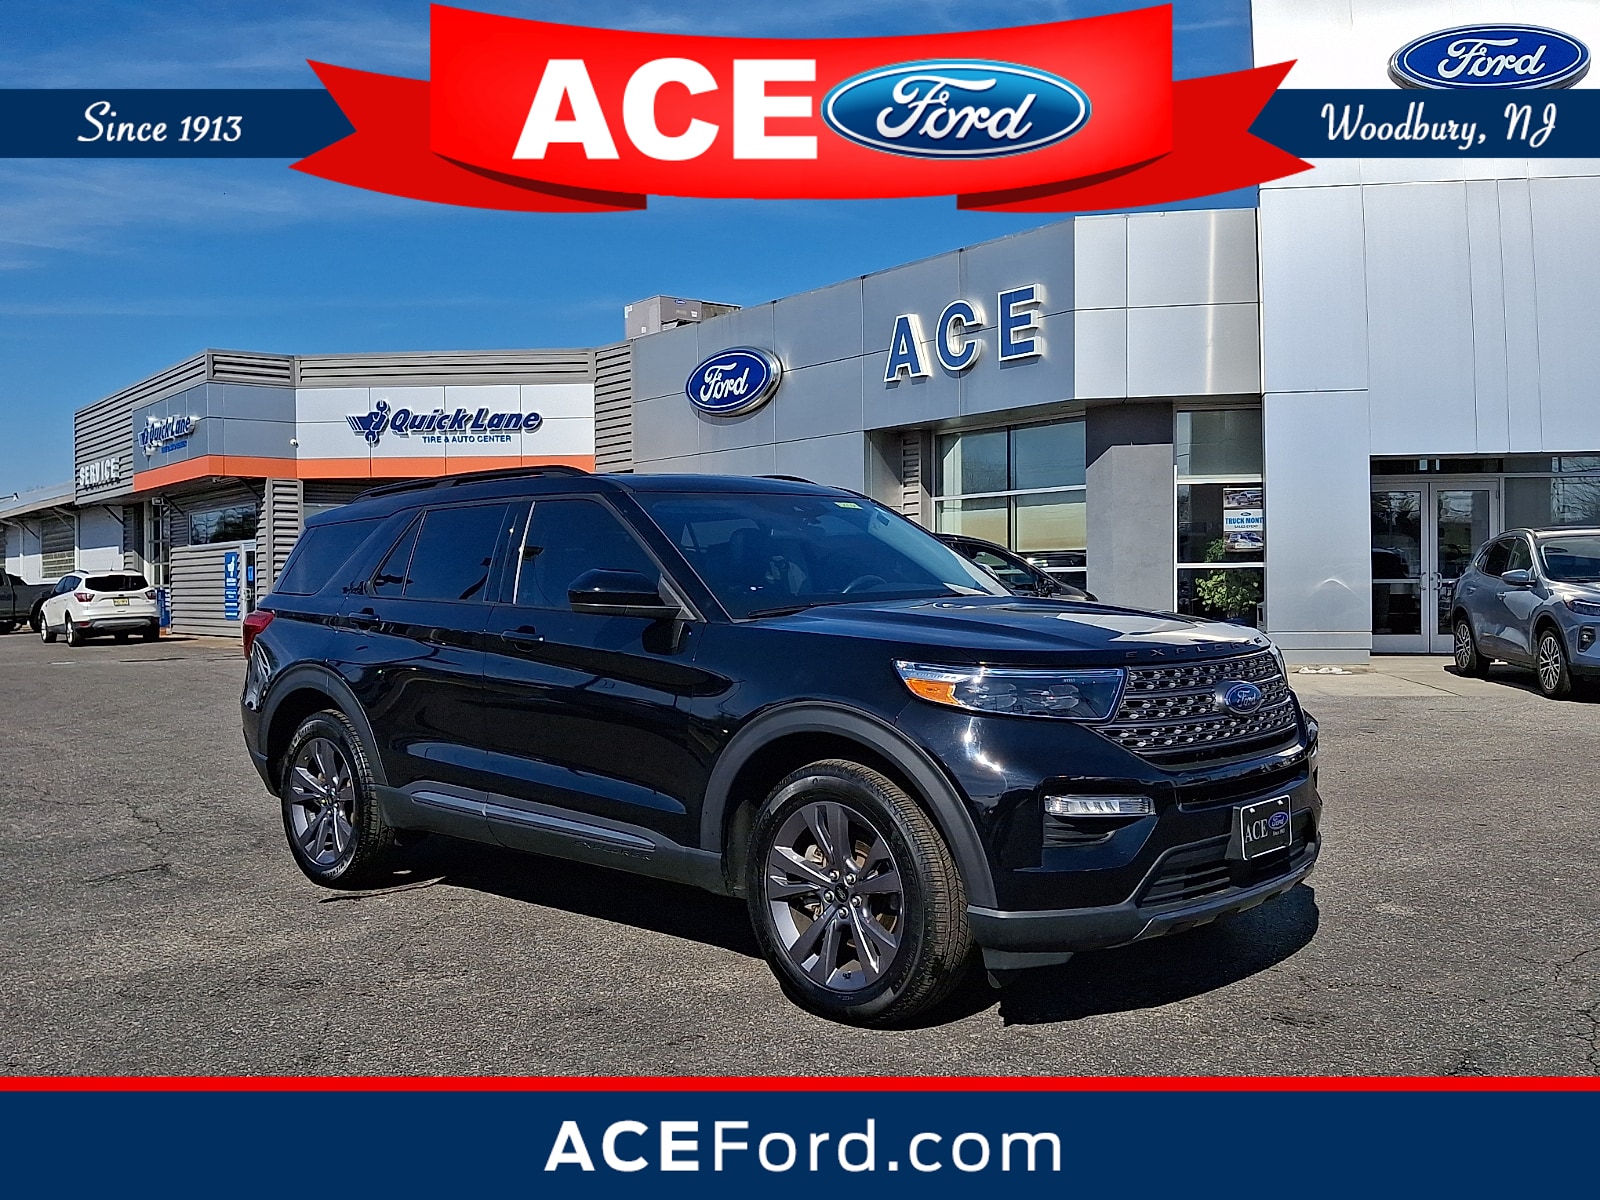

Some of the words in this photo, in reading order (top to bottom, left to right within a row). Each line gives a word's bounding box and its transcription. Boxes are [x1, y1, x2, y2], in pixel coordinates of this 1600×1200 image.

[1437, 38, 1547, 78] Ford
[884, 283, 1043, 382] ACE
[700, 362, 750, 402] Ford
[391, 408, 470, 435] Quick
[470, 408, 543, 434] Lane
[422, 436, 442, 444] TIRE
[451, 435, 475, 443] AUTO
[477, 435, 511, 443] CENTER
[80, 457, 120, 486] SERVICE
[1236, 690, 1257, 707] Ford
[1245, 818, 1268, 843] ACE
